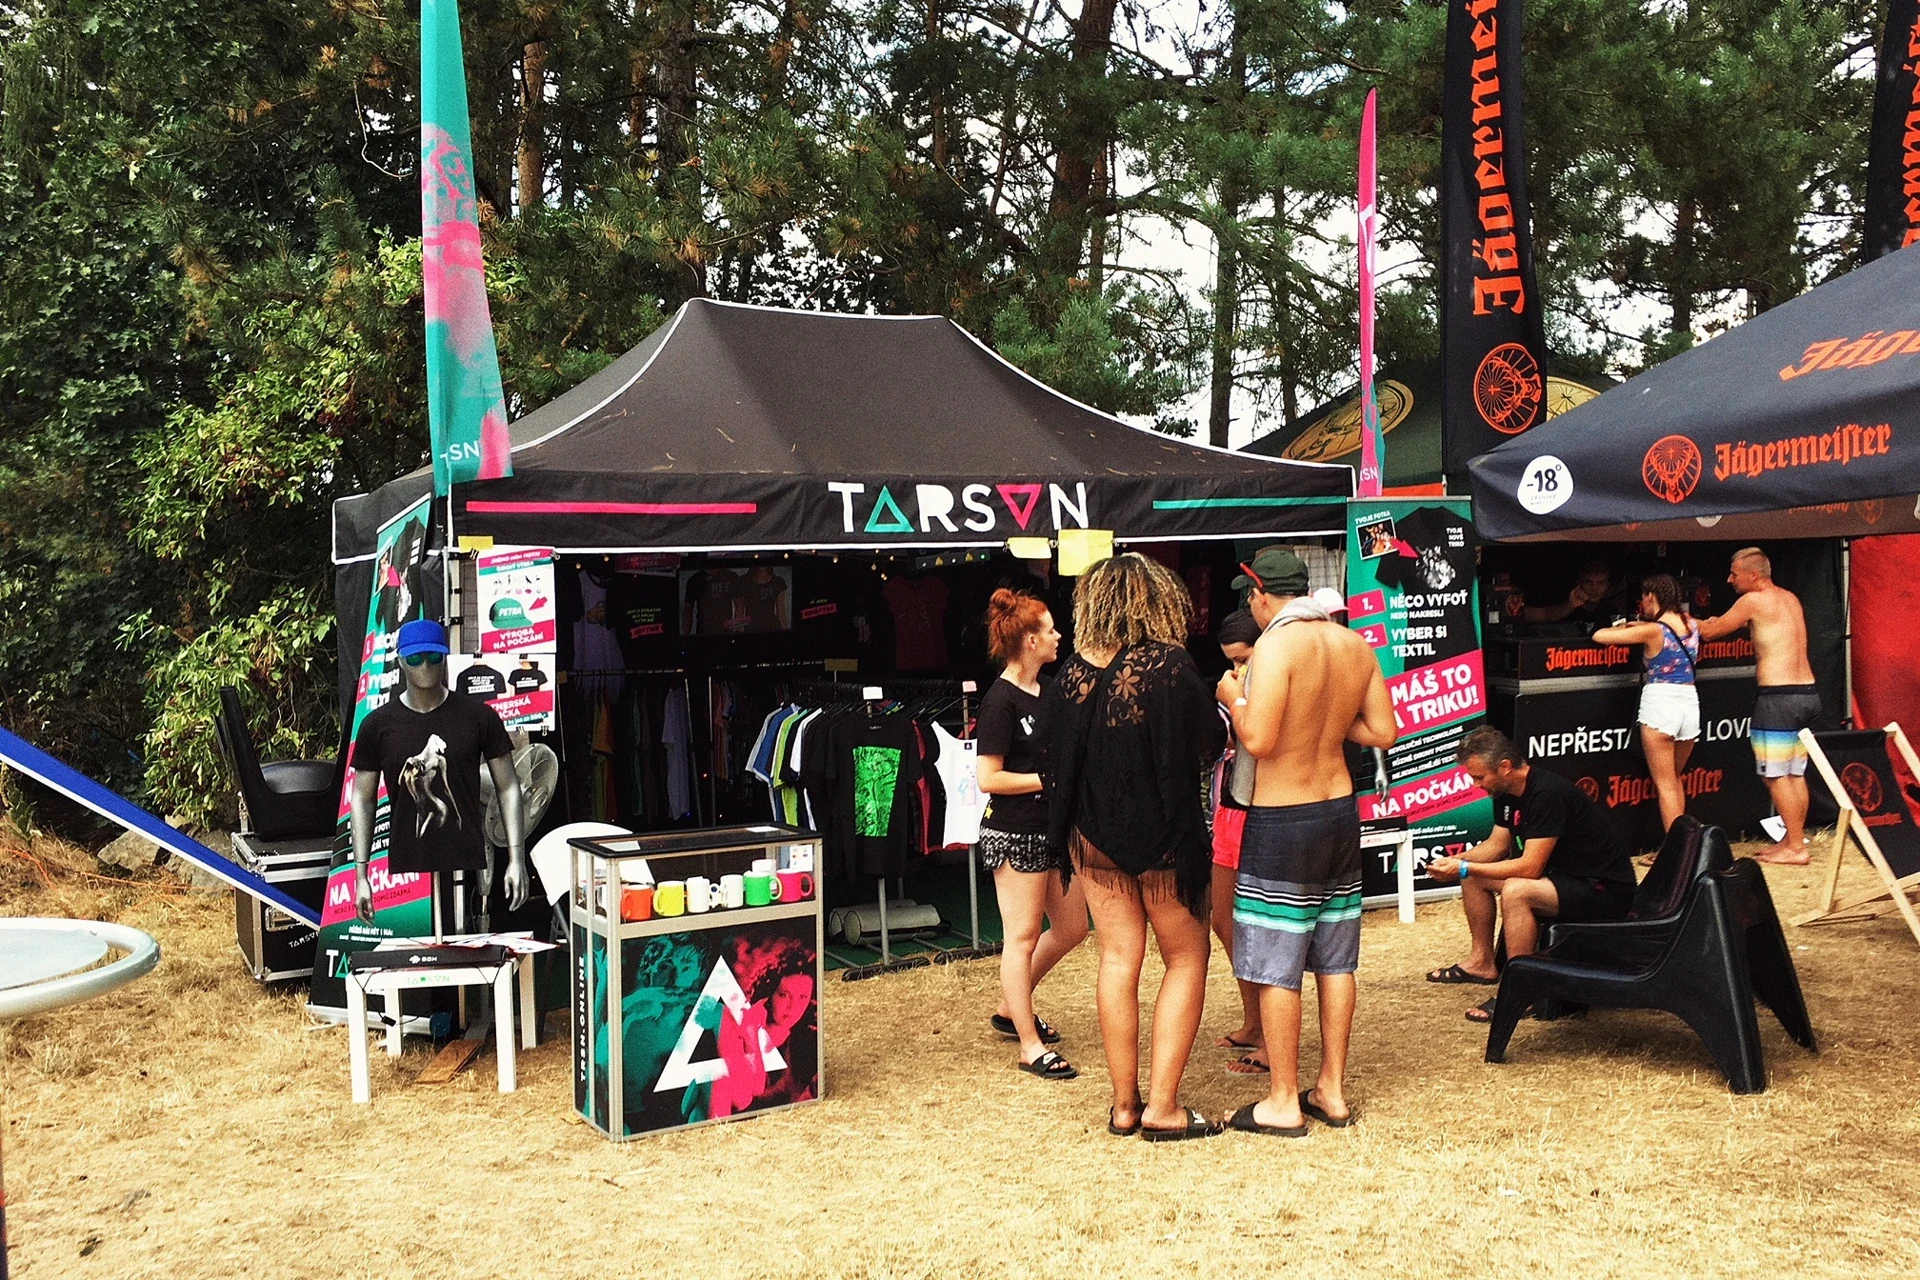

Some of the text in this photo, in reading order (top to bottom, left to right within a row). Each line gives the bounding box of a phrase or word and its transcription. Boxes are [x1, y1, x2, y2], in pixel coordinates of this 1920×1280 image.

[1714, 424, 1892, 481] Jägermeister
[499, 607, 522, 616] PETRA
[1389, 593, 1426, 610] NĚCO
[1428, 591, 1468, 608] VYFOŤ
[493, 632, 544, 650] NA POČKÁNÍ
[500, 627, 535, 640] VÝROBA
[1391, 626, 1433, 641] VYBER
[1435, 625, 1448, 639] SI
[1392, 643, 1436, 658] TEXTIL
[1546, 645, 1630, 672] Jägermeister
[1391, 664, 1472, 706] MÁŠ TO
[1406, 685, 1480, 724] TRIKU!
[1372, 773, 1475, 819] NA POČKÁN
[329, 881, 352, 907] NA
